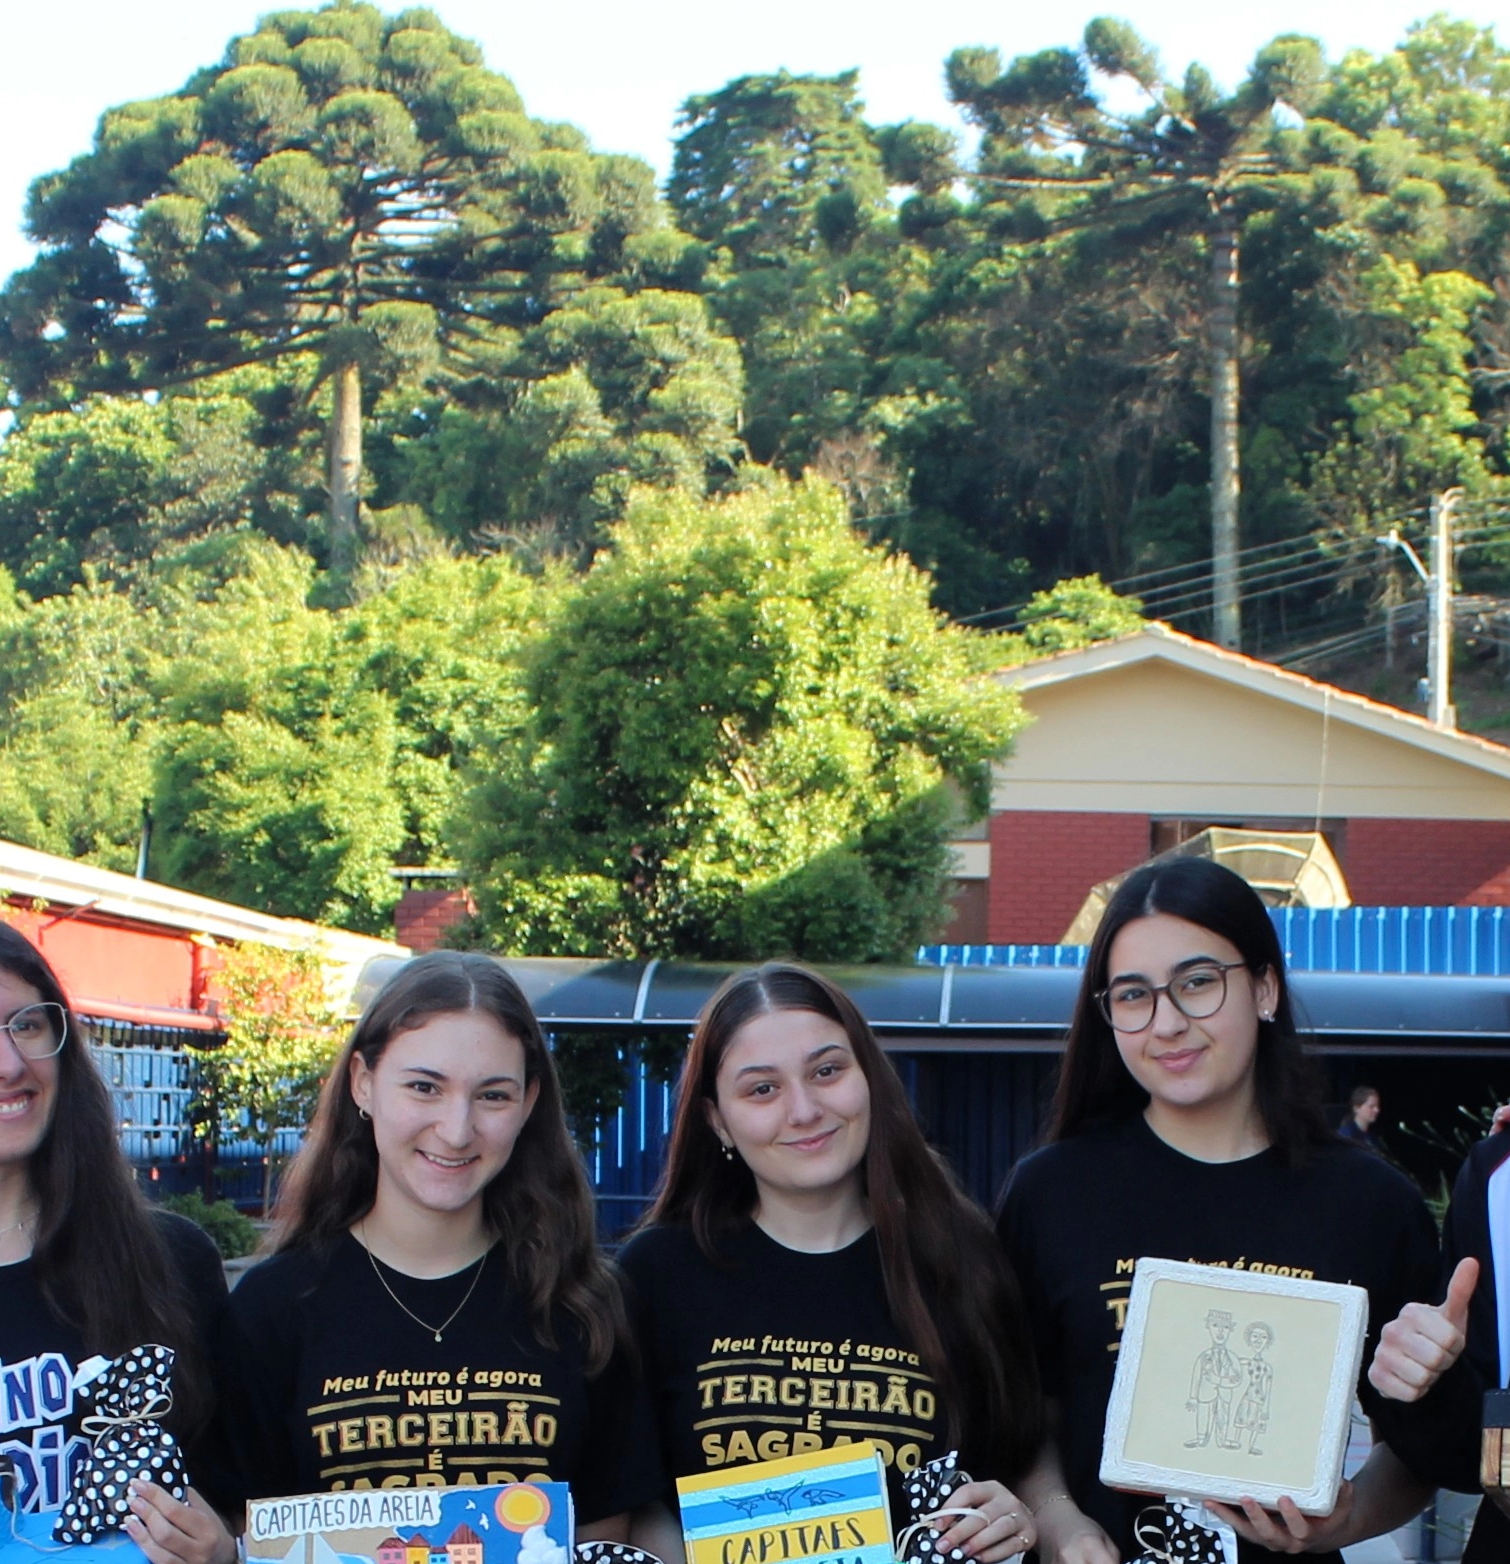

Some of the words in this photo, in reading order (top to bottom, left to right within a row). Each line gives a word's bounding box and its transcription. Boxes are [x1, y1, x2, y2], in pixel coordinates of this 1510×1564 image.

[711, 1337, 755, 1354] Meu
[761, 1335, 834, 1354] futuro
[839, 1339, 852, 1355] é
[856, 1344, 920, 1366] agora
[792, 1356, 845, 1373] MEU
[323, 1375, 369, 1396] Meu
[375, 1369, 449, 1391] futuro
[456, 1367, 469, 1385] é
[474, 1370, 542, 1387] agora
[408, 1389, 463, 1406] MEU
[697, 1374, 936, 1421] TERCEIRÃO
[312, 1401, 558, 1457] TERCEIRÃO
[807, 1411, 822, 1431] É
[428, 1449, 443, 1470] É
[255, 1497, 345, 1536] CAPITÃES
[349, 1498, 372, 1524] DA
[379, 1495, 434, 1522] AREIA
